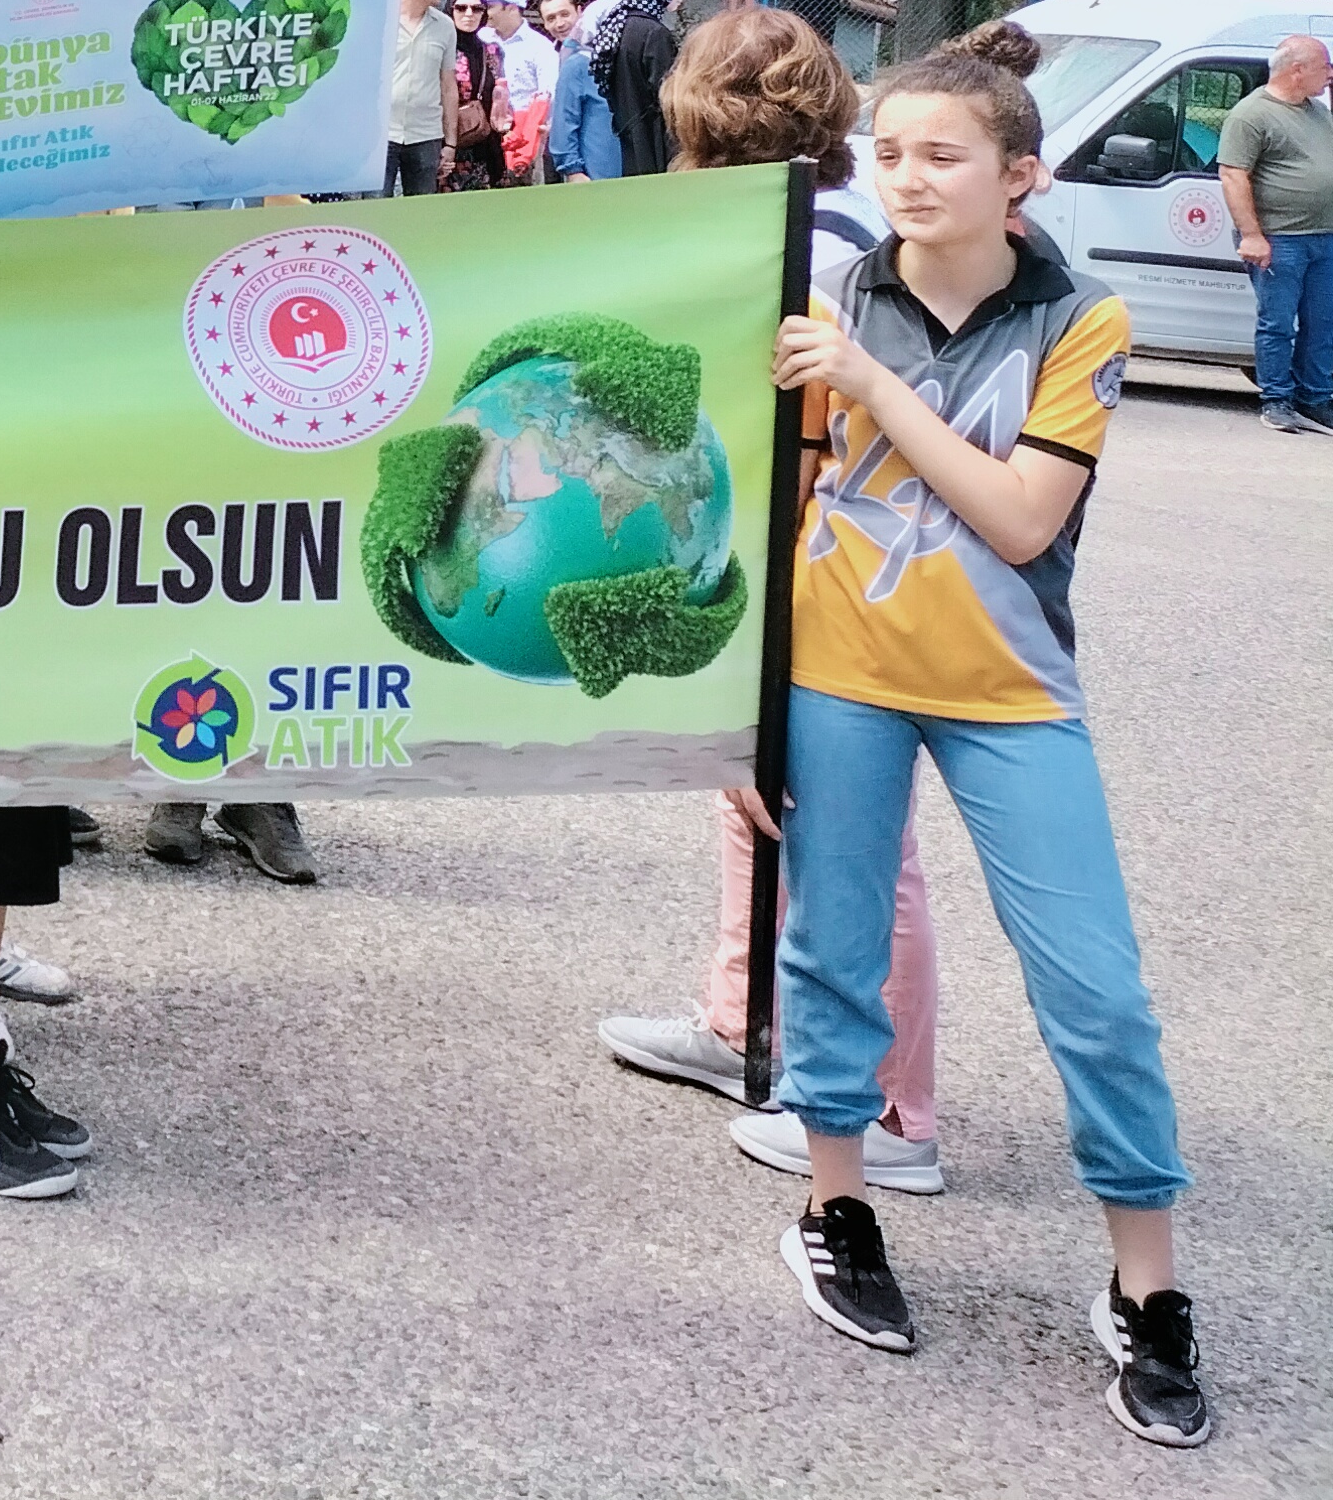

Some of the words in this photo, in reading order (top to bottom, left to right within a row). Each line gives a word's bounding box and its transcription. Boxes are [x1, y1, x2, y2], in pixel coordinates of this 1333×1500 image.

[165, 10, 313, 47] TÜRKİYE
[180, 39, 295, 74] ÇEVRE
[164, 63, 308, 97] HAFTASI
[191, 97, 216, 107] 01-07
[44, 124, 95, 145] Atık
[271, 261, 317, 282] ÇEVRE
[321, 264, 339, 279] VE
[233, 273, 270, 363] CUMHURİYETİ
[336, 273, 383, 341] ŞEHİRCİLİK
[249, 363, 303, 404] TÜRKİYE
[327, 344, 383, 404] BAKANLIĞI
[56, 501, 341, 607] OLSUN
[268, 664, 411, 712] SIFIR
[266, 715, 412, 769] ATIK
